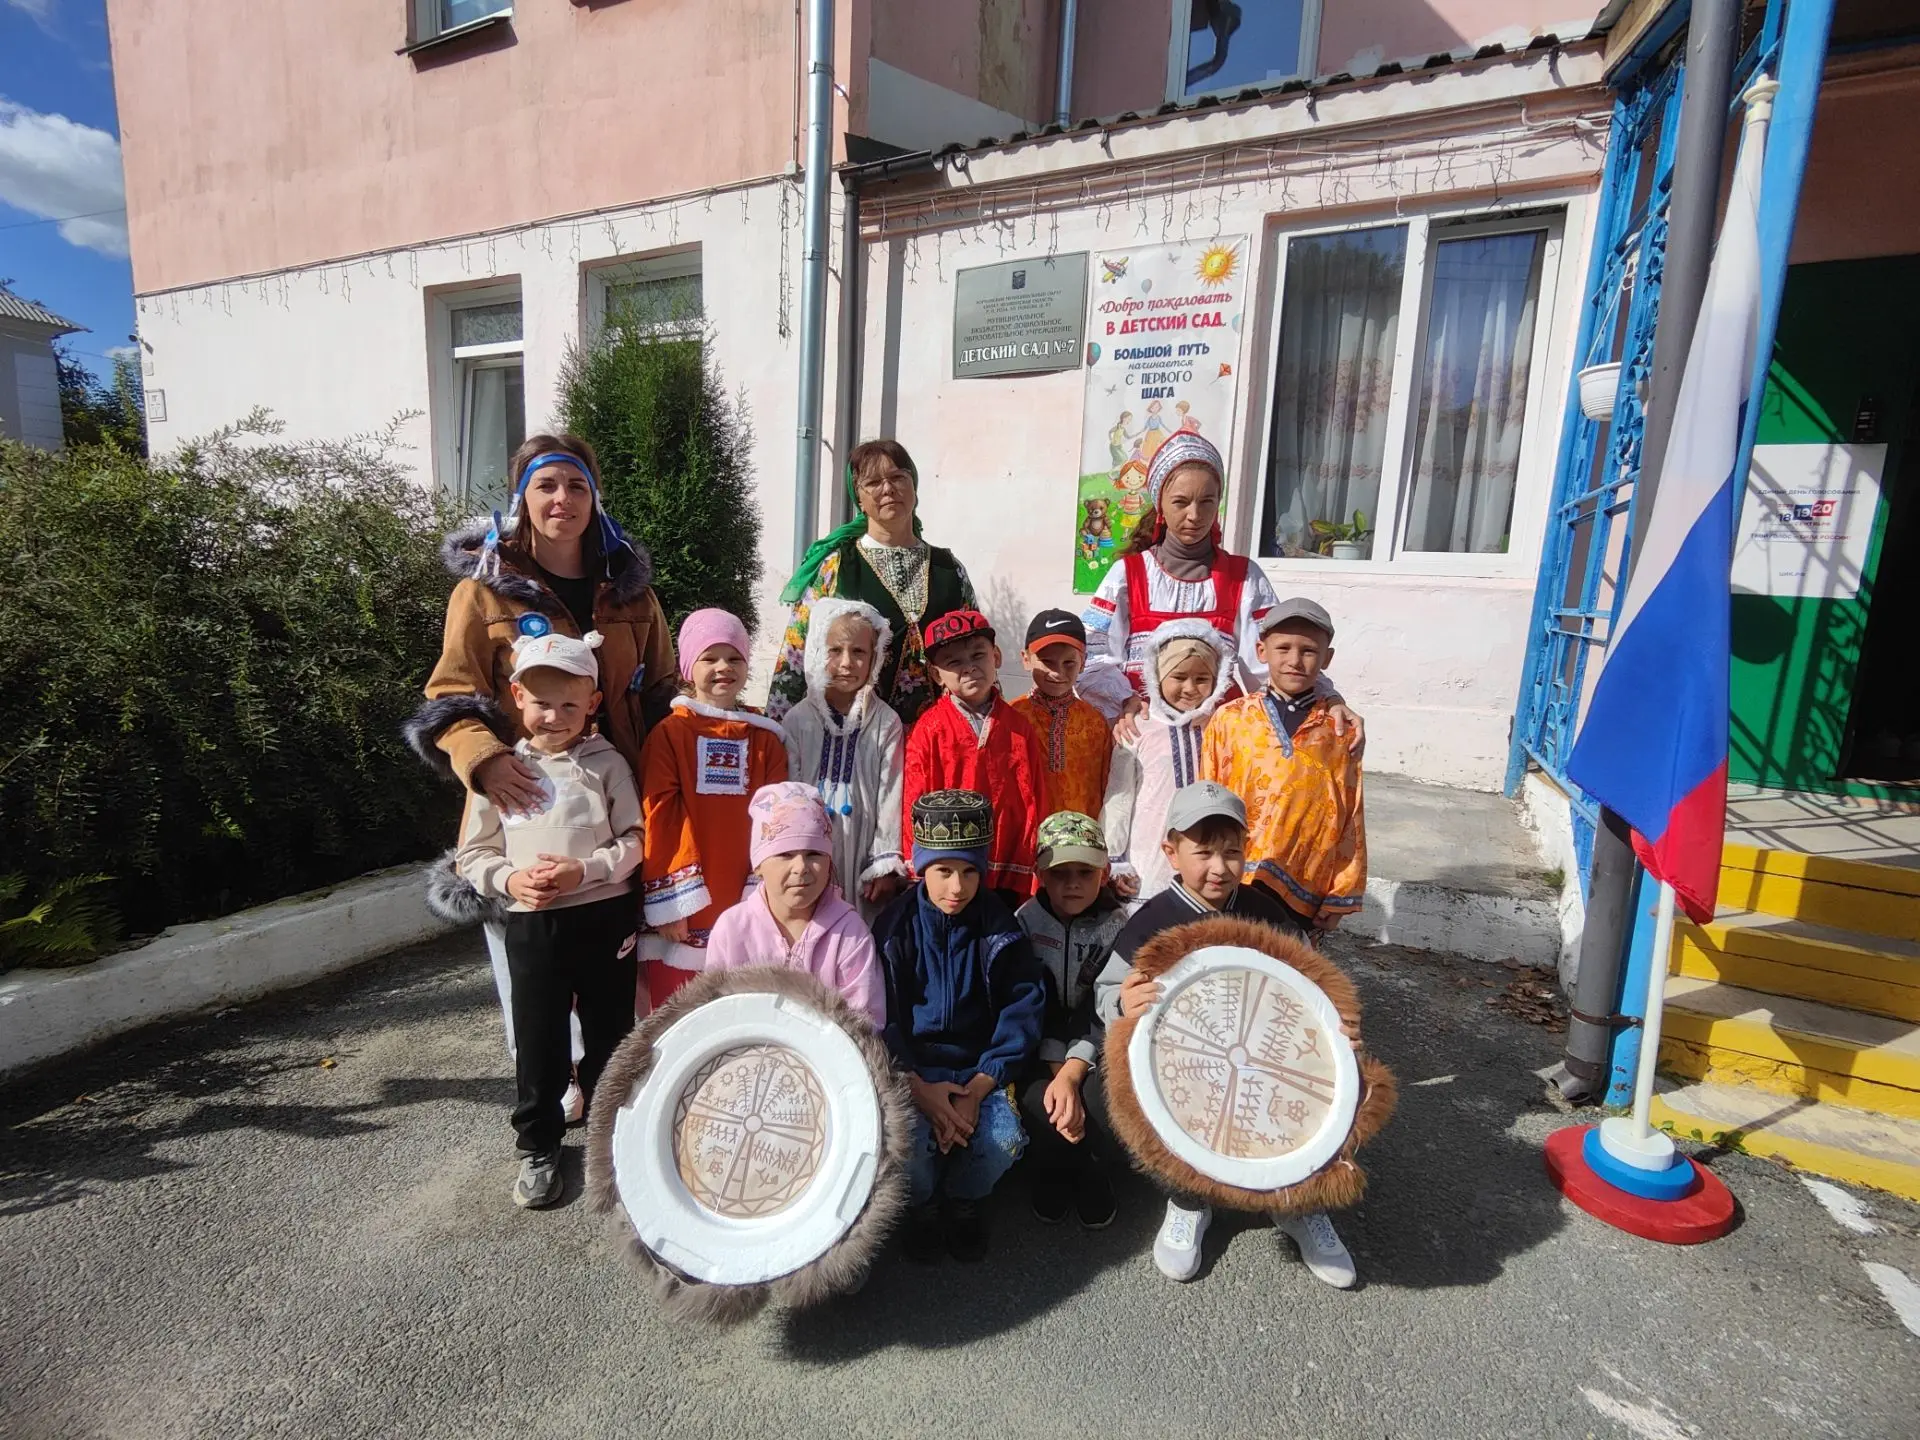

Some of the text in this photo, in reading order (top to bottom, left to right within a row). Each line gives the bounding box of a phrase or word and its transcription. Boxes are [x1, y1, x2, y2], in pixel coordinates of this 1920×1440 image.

[1147, 292, 1233, 312] пожаловать
[1014, 319, 1062, 329] ДОШКОЛЬНОЕ
[1106, 321, 1116, 335] В
[1119, 313, 1187, 335] ДЕТСКИЙ
[963, 326, 1072, 342] ОБРАЗОВАТЕЛЬНОЕ УЧРЕЖДЕНИЕ
[959, 342, 1017, 366] ДЕТСКИЙ
[1021, 340, 1050, 359] САД
[1114, 342, 1210, 361] БОЛЬШОЙ ПУТЬ
[1128, 359, 1194, 370] начинается
[1125, 371, 1193, 385] С ПЕРВОГО
[1141, 386, 1175, 400] ШАГА
[1778, 503, 1832, 522] 18 19 20
[933, 615, 977, 643] BOY
